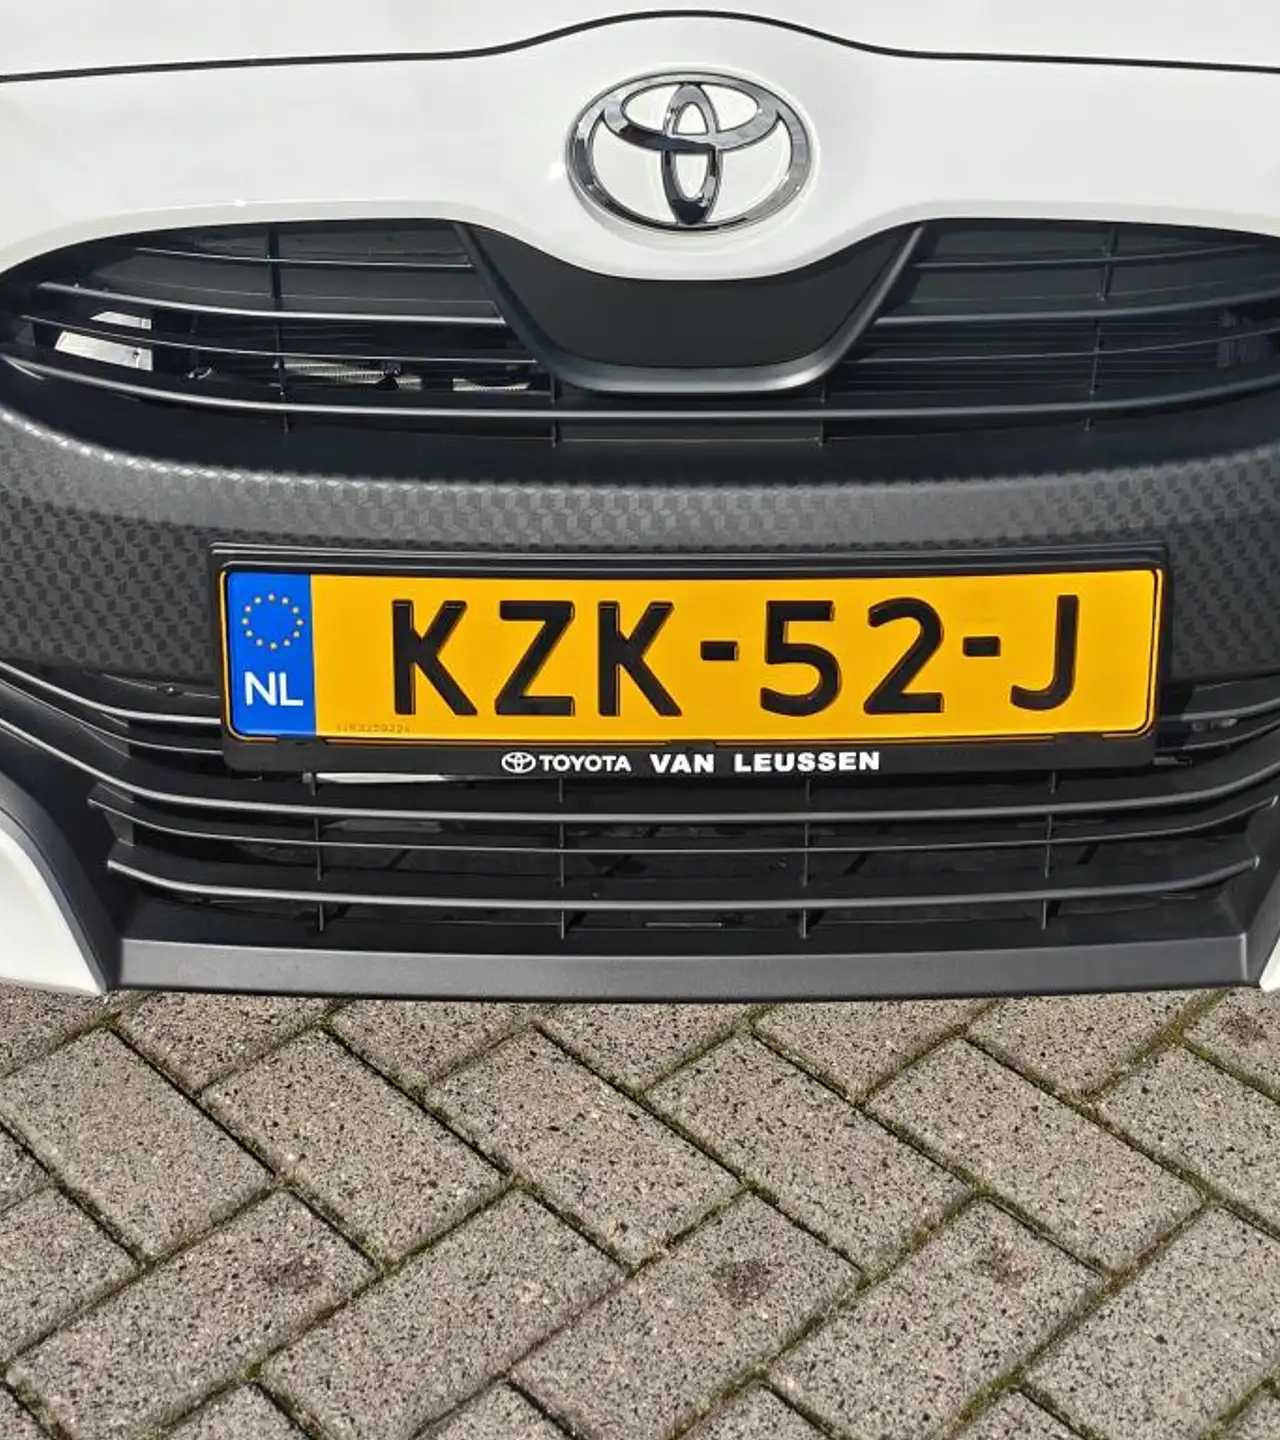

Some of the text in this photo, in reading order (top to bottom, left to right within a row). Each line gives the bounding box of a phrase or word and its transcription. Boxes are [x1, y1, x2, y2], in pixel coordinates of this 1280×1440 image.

[391, 594, 1080, 718] KZK-52-J
[244, 671, 304, 707] NL
[538, 751, 880, 774] TOYOTA VAN LEUSSEN
